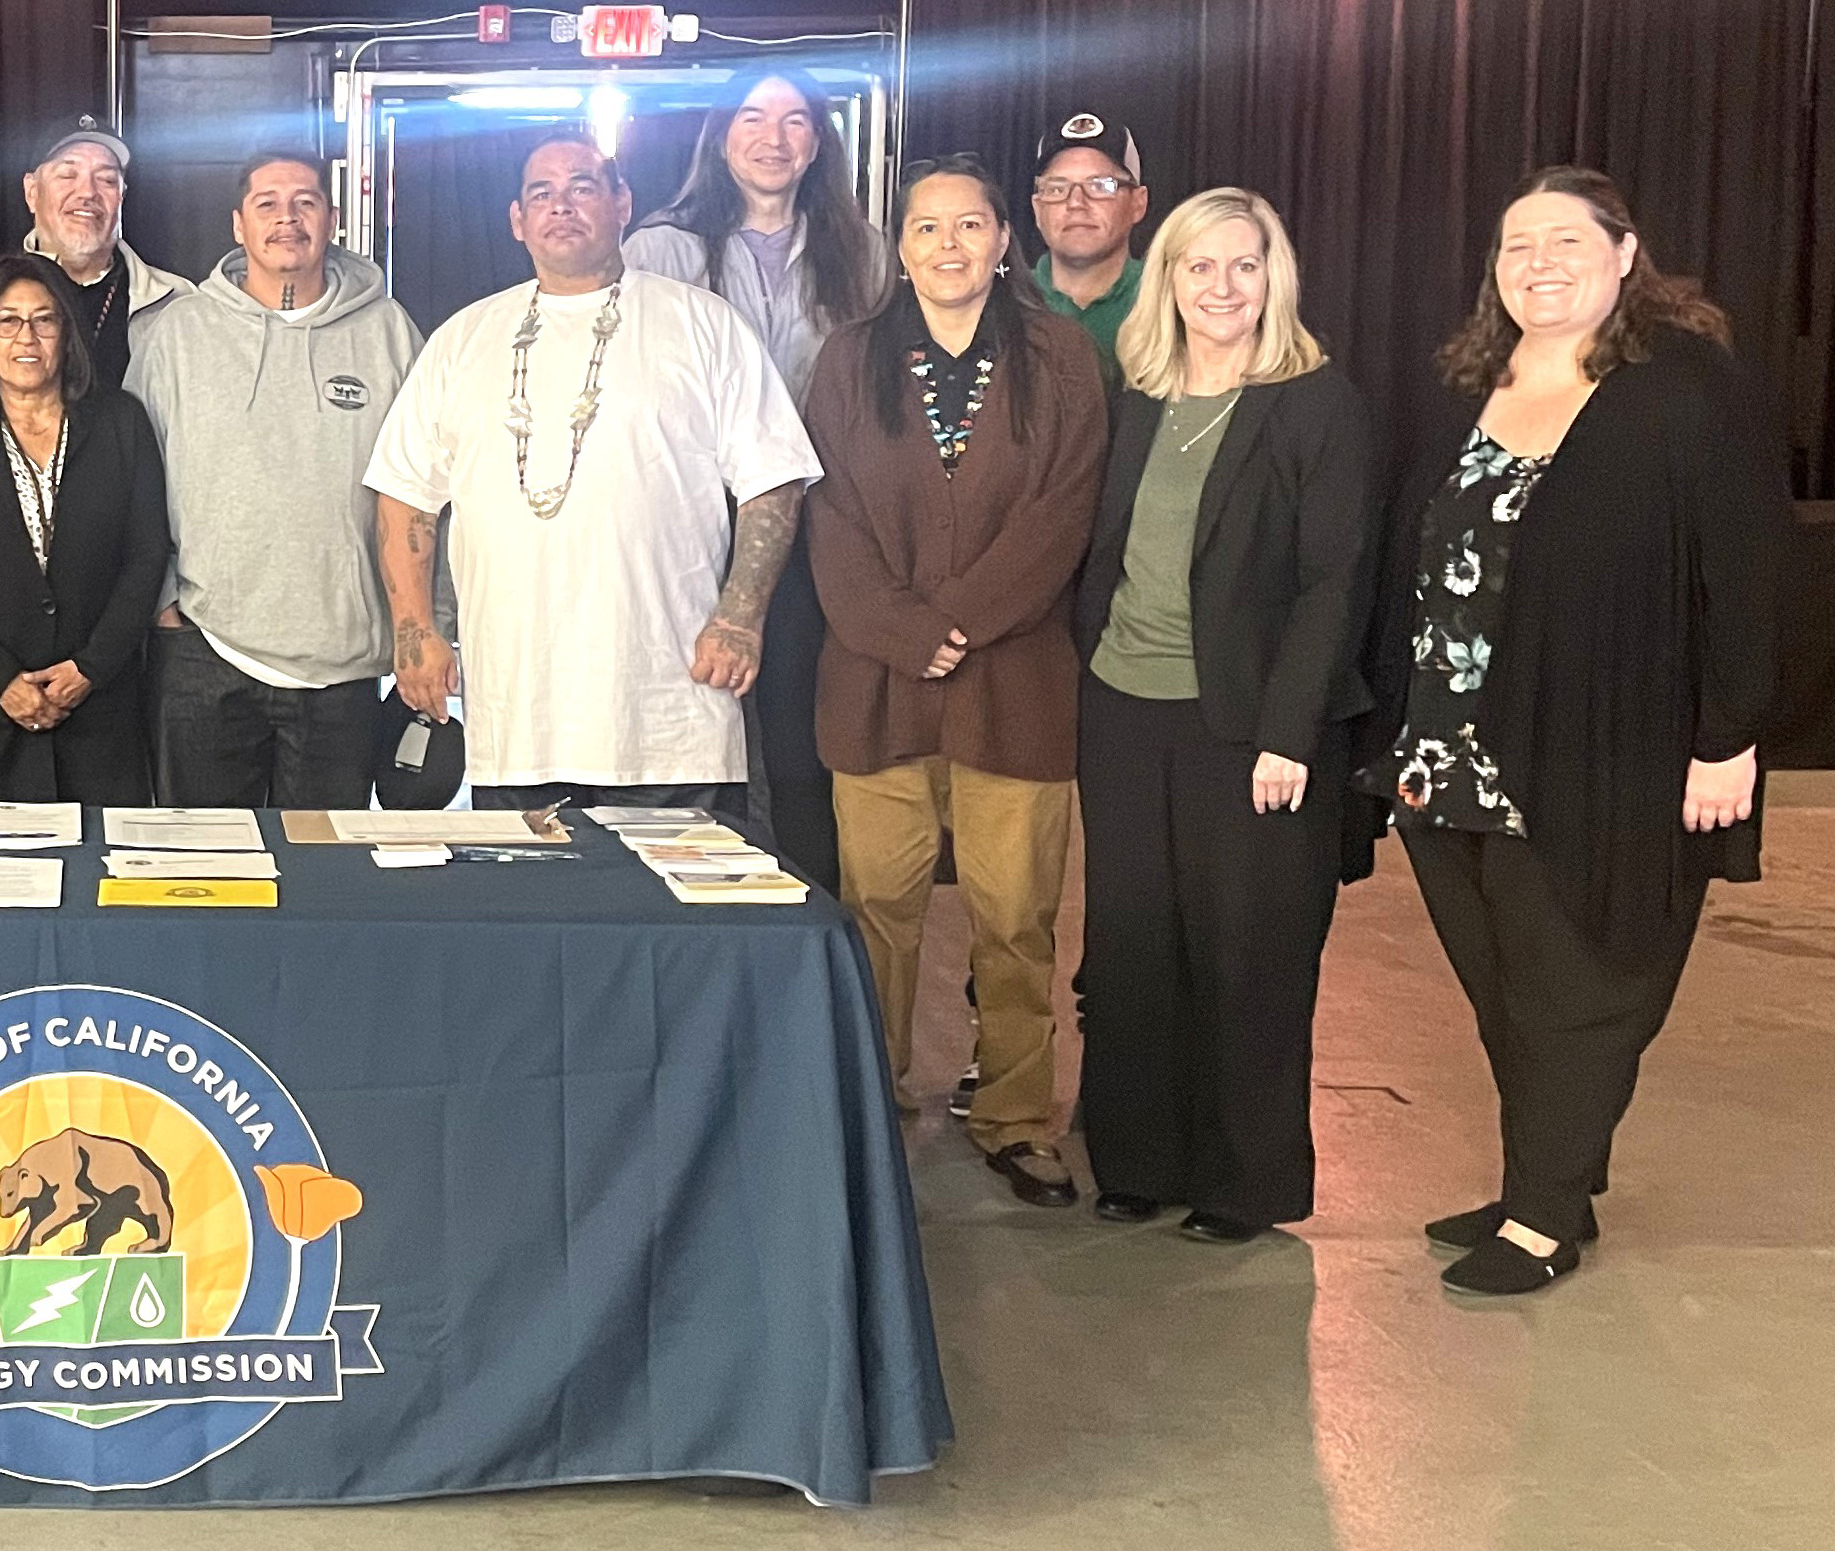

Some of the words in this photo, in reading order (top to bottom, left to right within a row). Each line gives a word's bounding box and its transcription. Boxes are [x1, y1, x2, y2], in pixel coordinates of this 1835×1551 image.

[596, 8, 653, 53] EXIT
[44, 1016, 275, 1151] CALIFORNIA
[52, 1352, 314, 1391] COMMISSION
